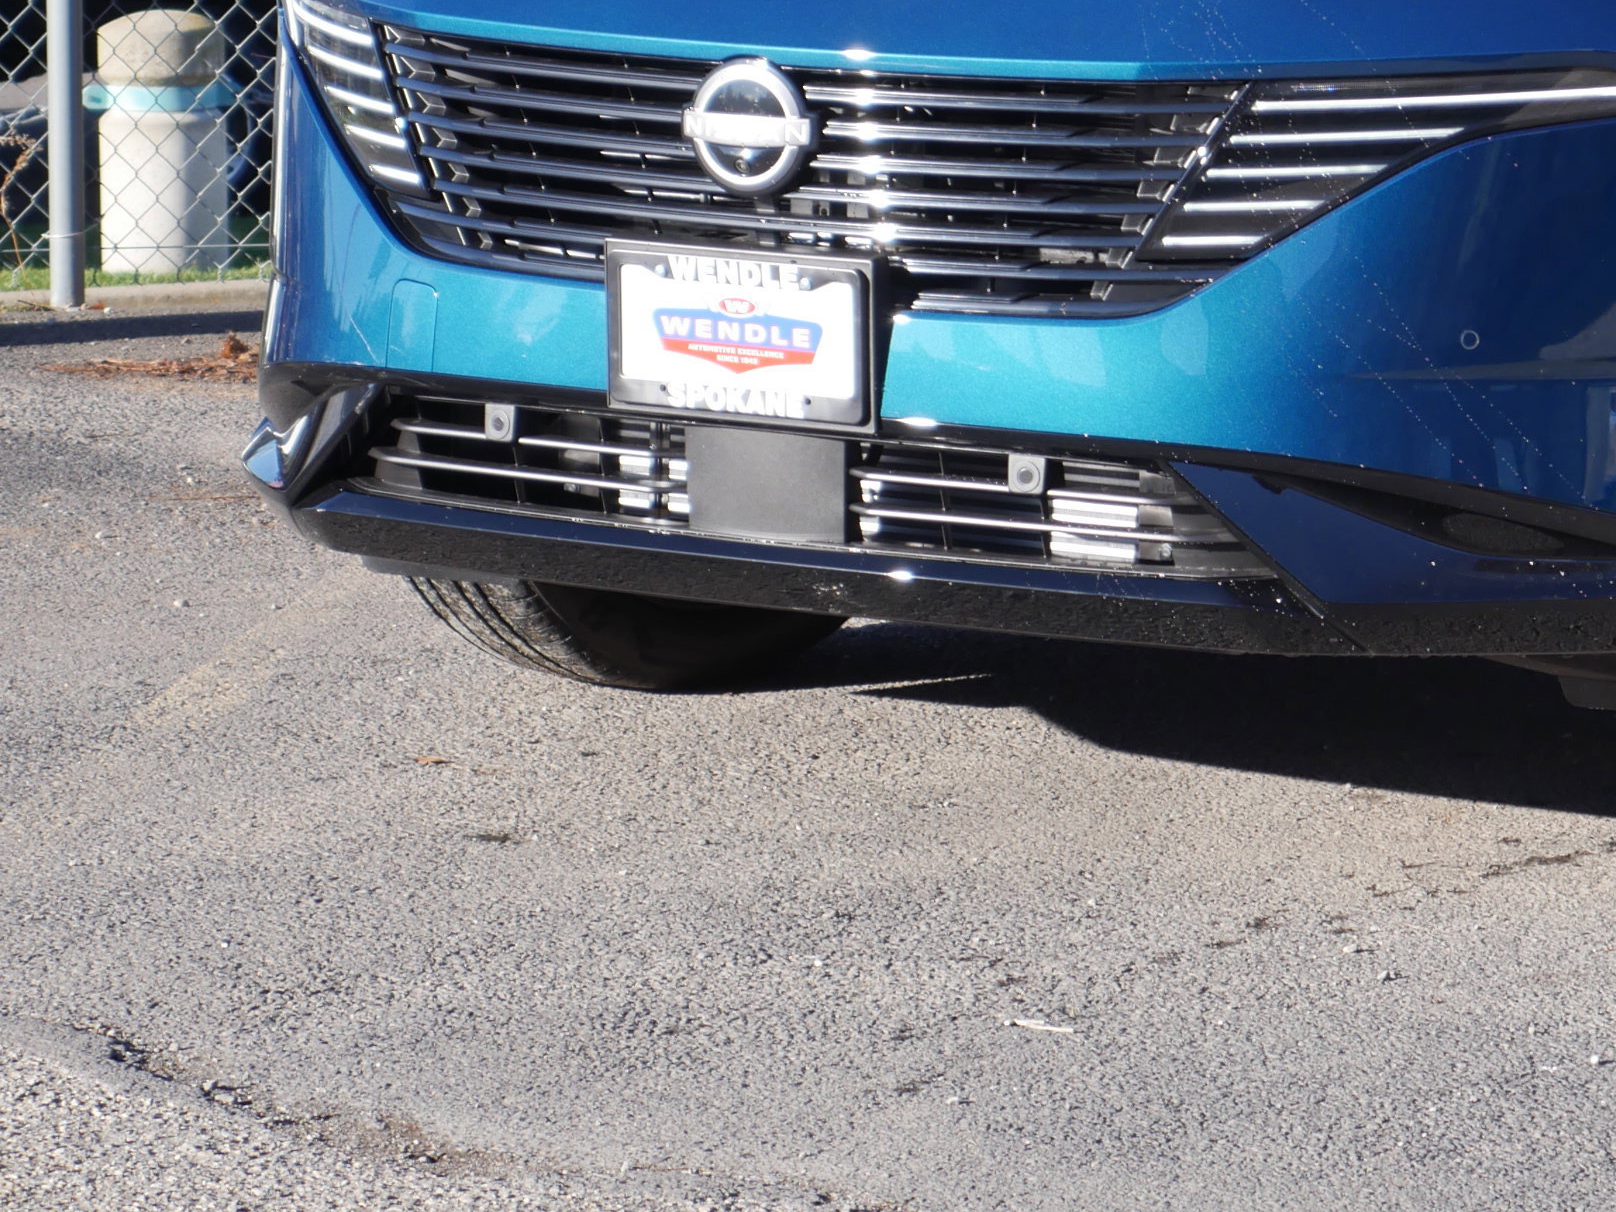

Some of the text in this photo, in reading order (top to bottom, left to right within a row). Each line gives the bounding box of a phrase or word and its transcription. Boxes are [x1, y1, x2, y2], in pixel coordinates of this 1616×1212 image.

[686, 114, 808, 143] NIAN
[667, 255, 800, 290] WENDLE
[660, 316, 811, 348] WENDLE
[737, 347, 785, 359] EXCELLENCE
[667, 381, 805, 419] SPOKANE
